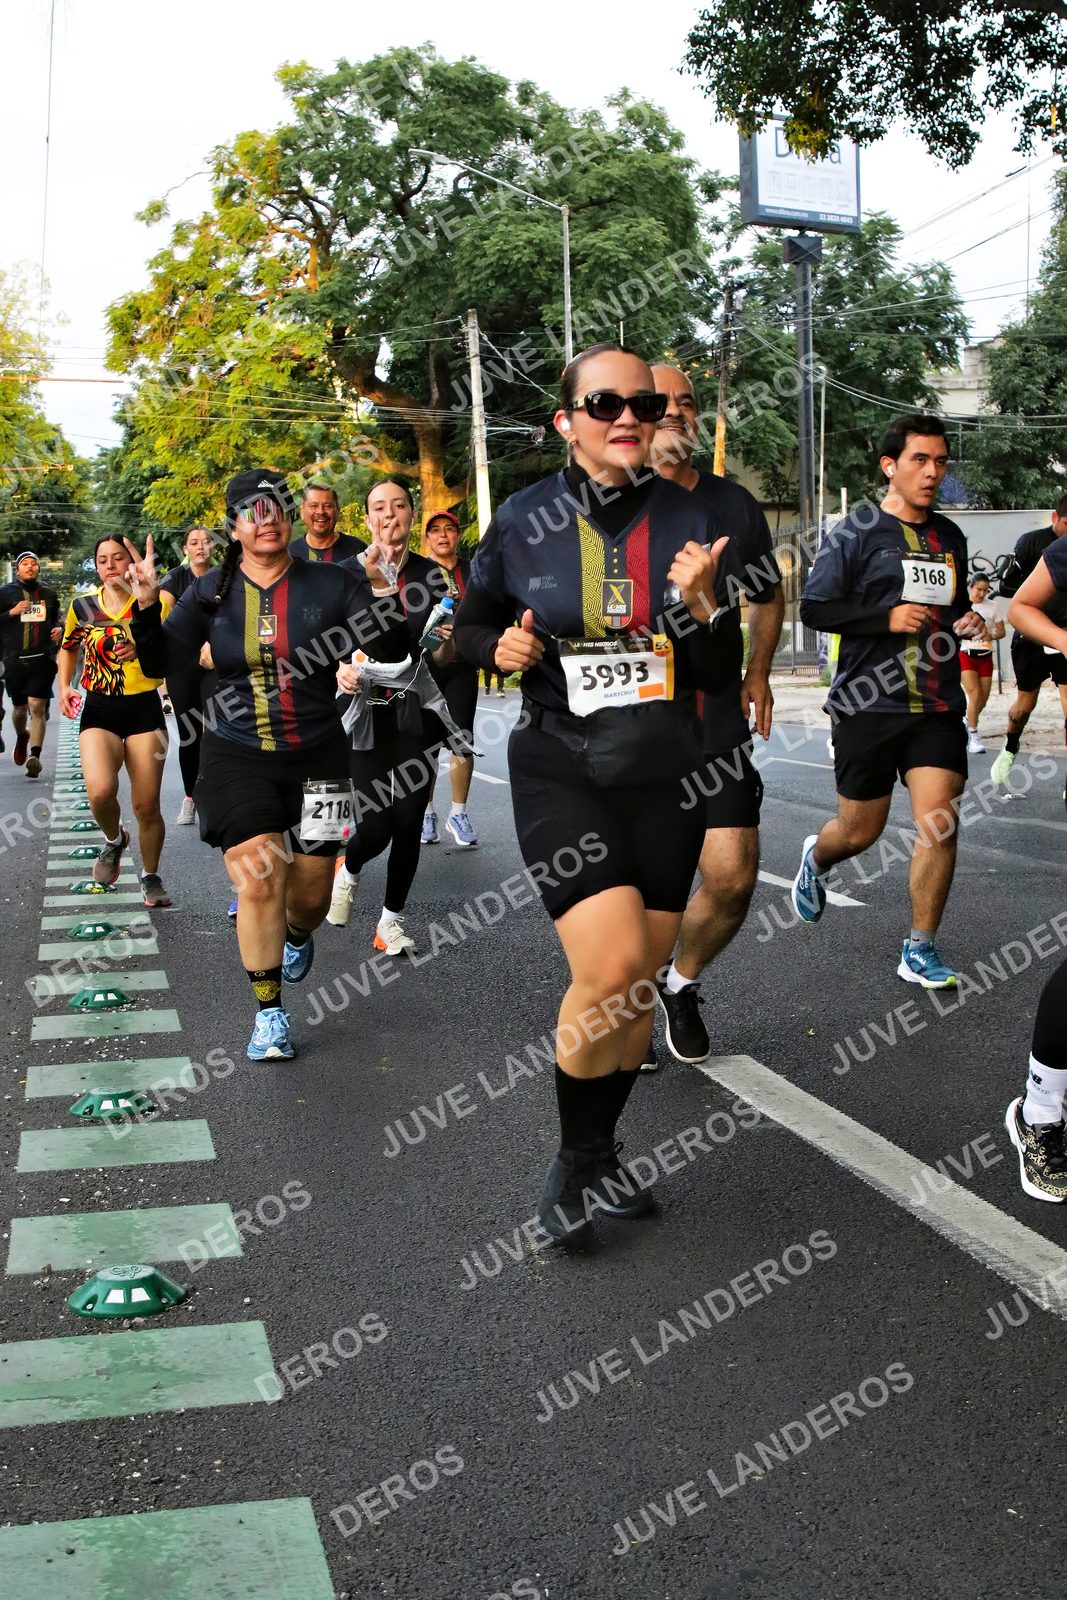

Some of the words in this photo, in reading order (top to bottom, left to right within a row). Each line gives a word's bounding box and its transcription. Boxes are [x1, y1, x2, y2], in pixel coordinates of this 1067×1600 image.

[912, 566, 946, 586] 3168
[580, 660, 649, 691] 5993
[311, 799, 350, 819] 2118
